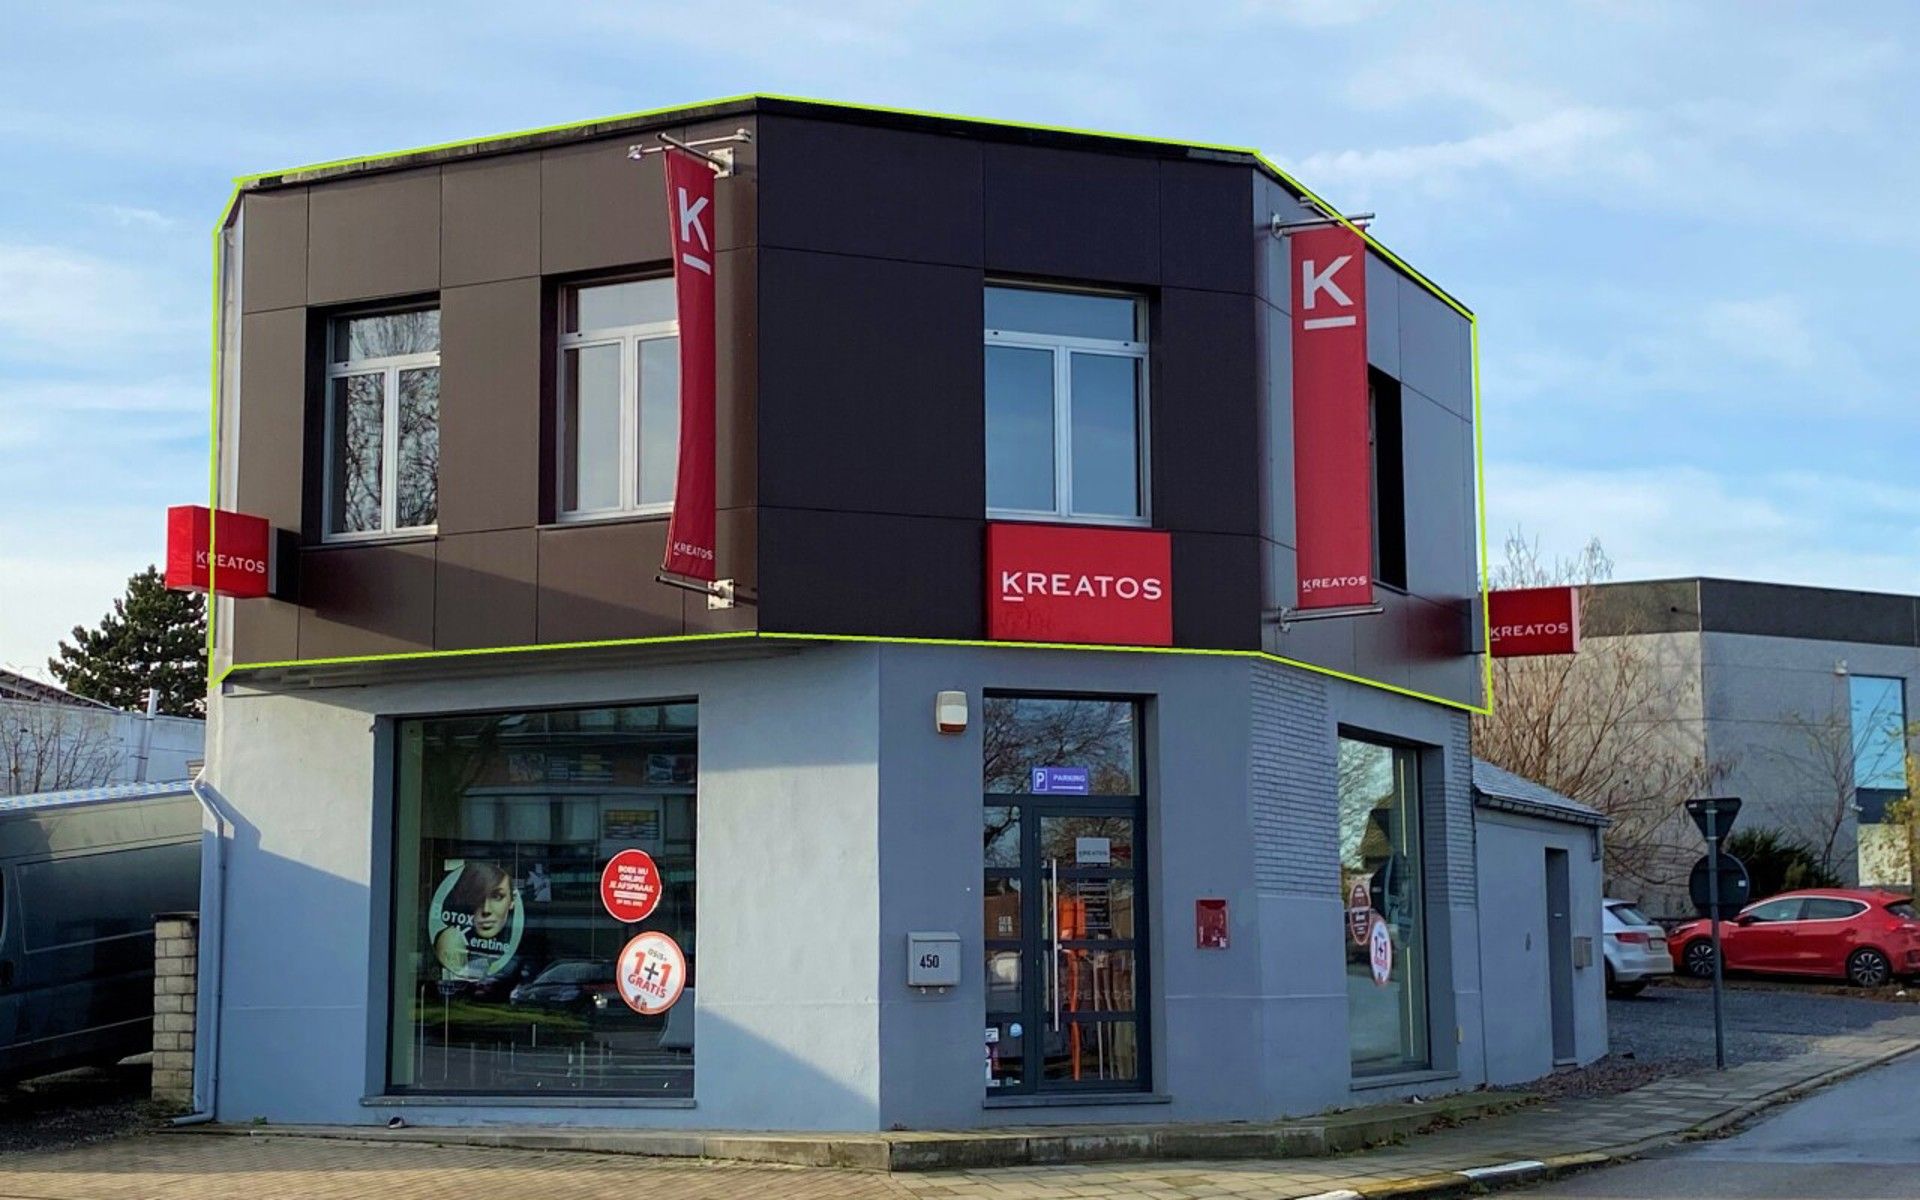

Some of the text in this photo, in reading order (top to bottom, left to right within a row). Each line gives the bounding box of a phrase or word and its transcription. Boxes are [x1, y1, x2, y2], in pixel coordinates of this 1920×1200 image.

[678, 187, 709, 253] K
[1303, 255, 1354, 309] K
[673, 541, 713, 560] KREATOS
[1002, 571, 1162, 601] KREATOS
[1303, 576, 1367, 592] KREATOS
[1490, 623, 1569, 642] KREATOS
[634, 951, 672, 988] 1+1
[920, 954, 940, 969] 450
[628, 974, 667, 998] GRATIS
